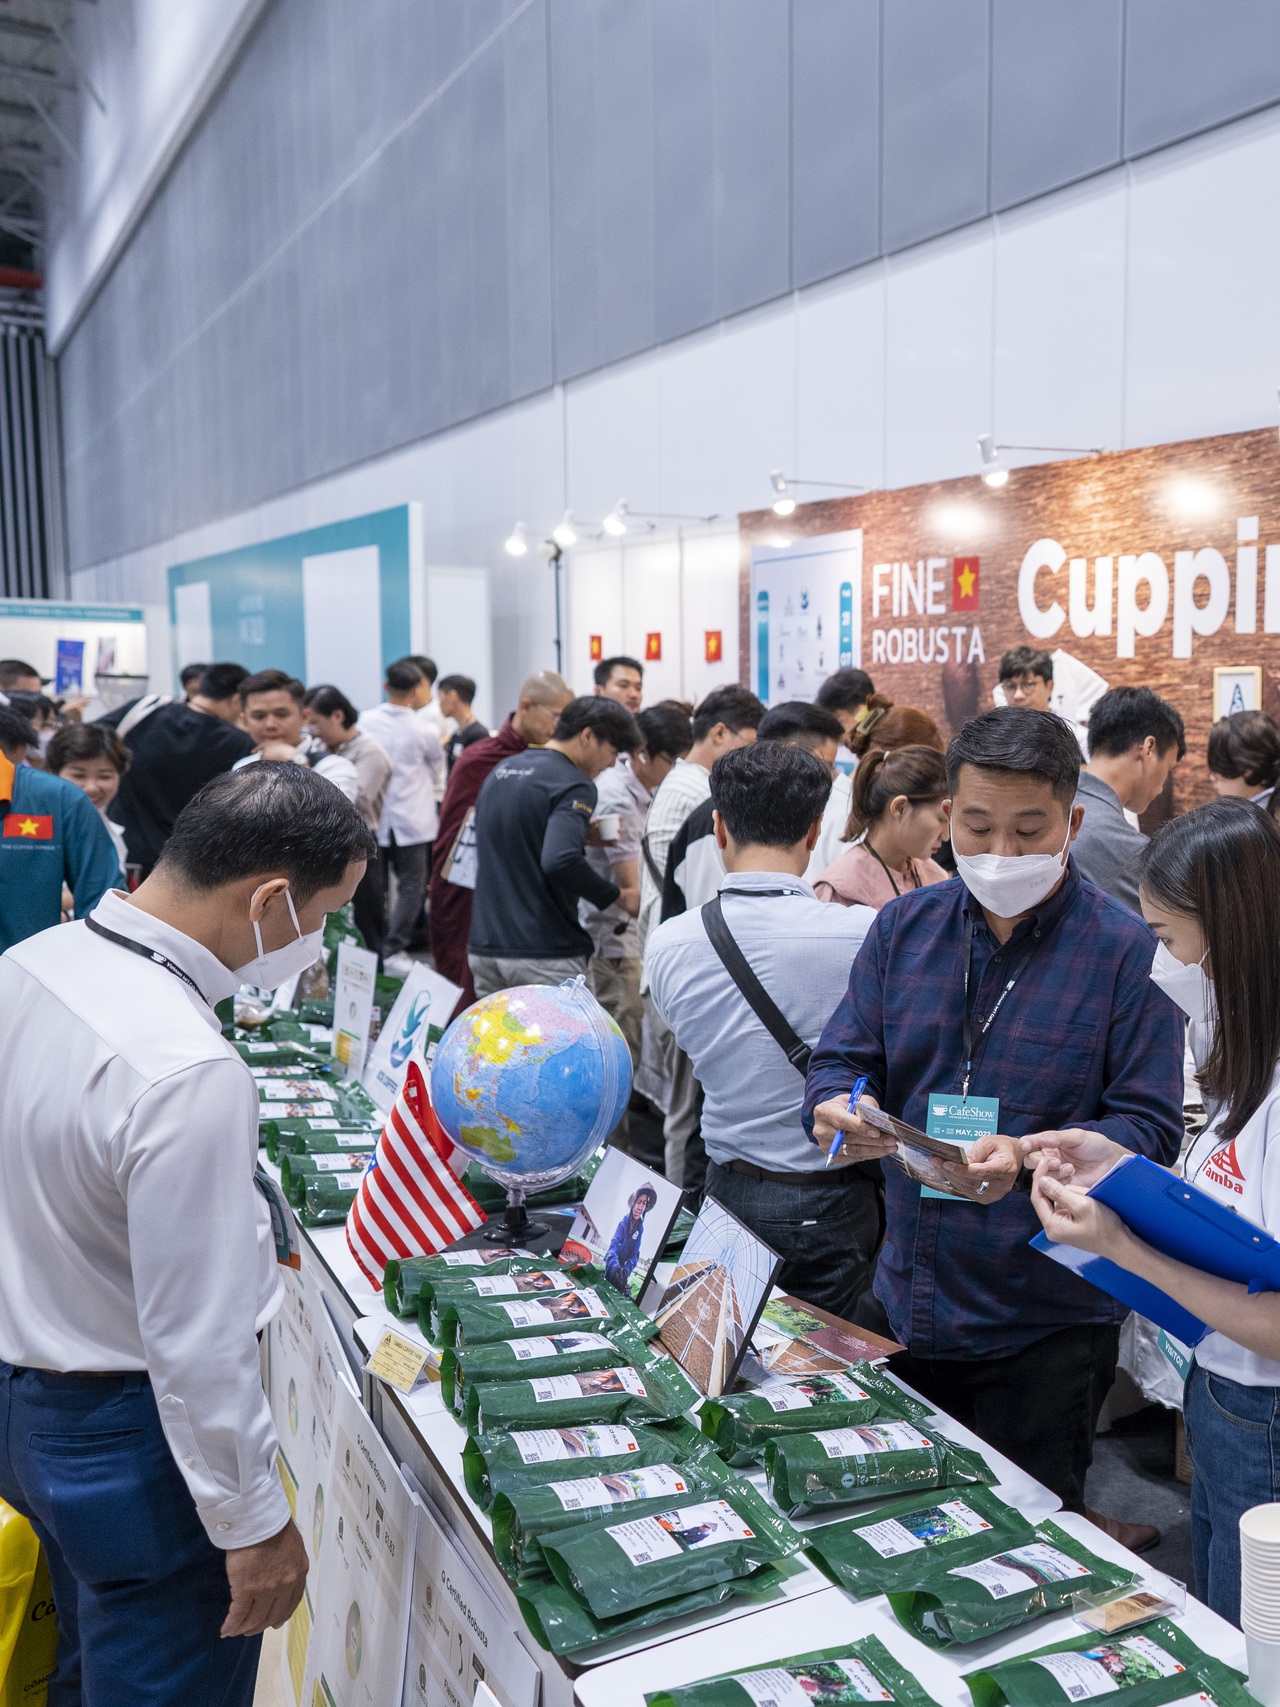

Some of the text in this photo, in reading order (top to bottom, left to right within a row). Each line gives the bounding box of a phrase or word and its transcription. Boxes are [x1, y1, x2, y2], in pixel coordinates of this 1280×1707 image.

[872, 558, 947, 619] FINE
[872, 626, 986, 664] ROBUSTA
[997, 991, 1007, 1006] Vietnam
[981, 1022, 990, 1033] Show
[949, 1105, 995, 1118] CafeShow
[956, 1129, 973, 1137] MAY,
[1202, 1159, 1243, 1195] Tamba
[1165, 1340, 1184, 1369] VISITOR
[441, 1570, 488, 1648] Q Certified Robusta
